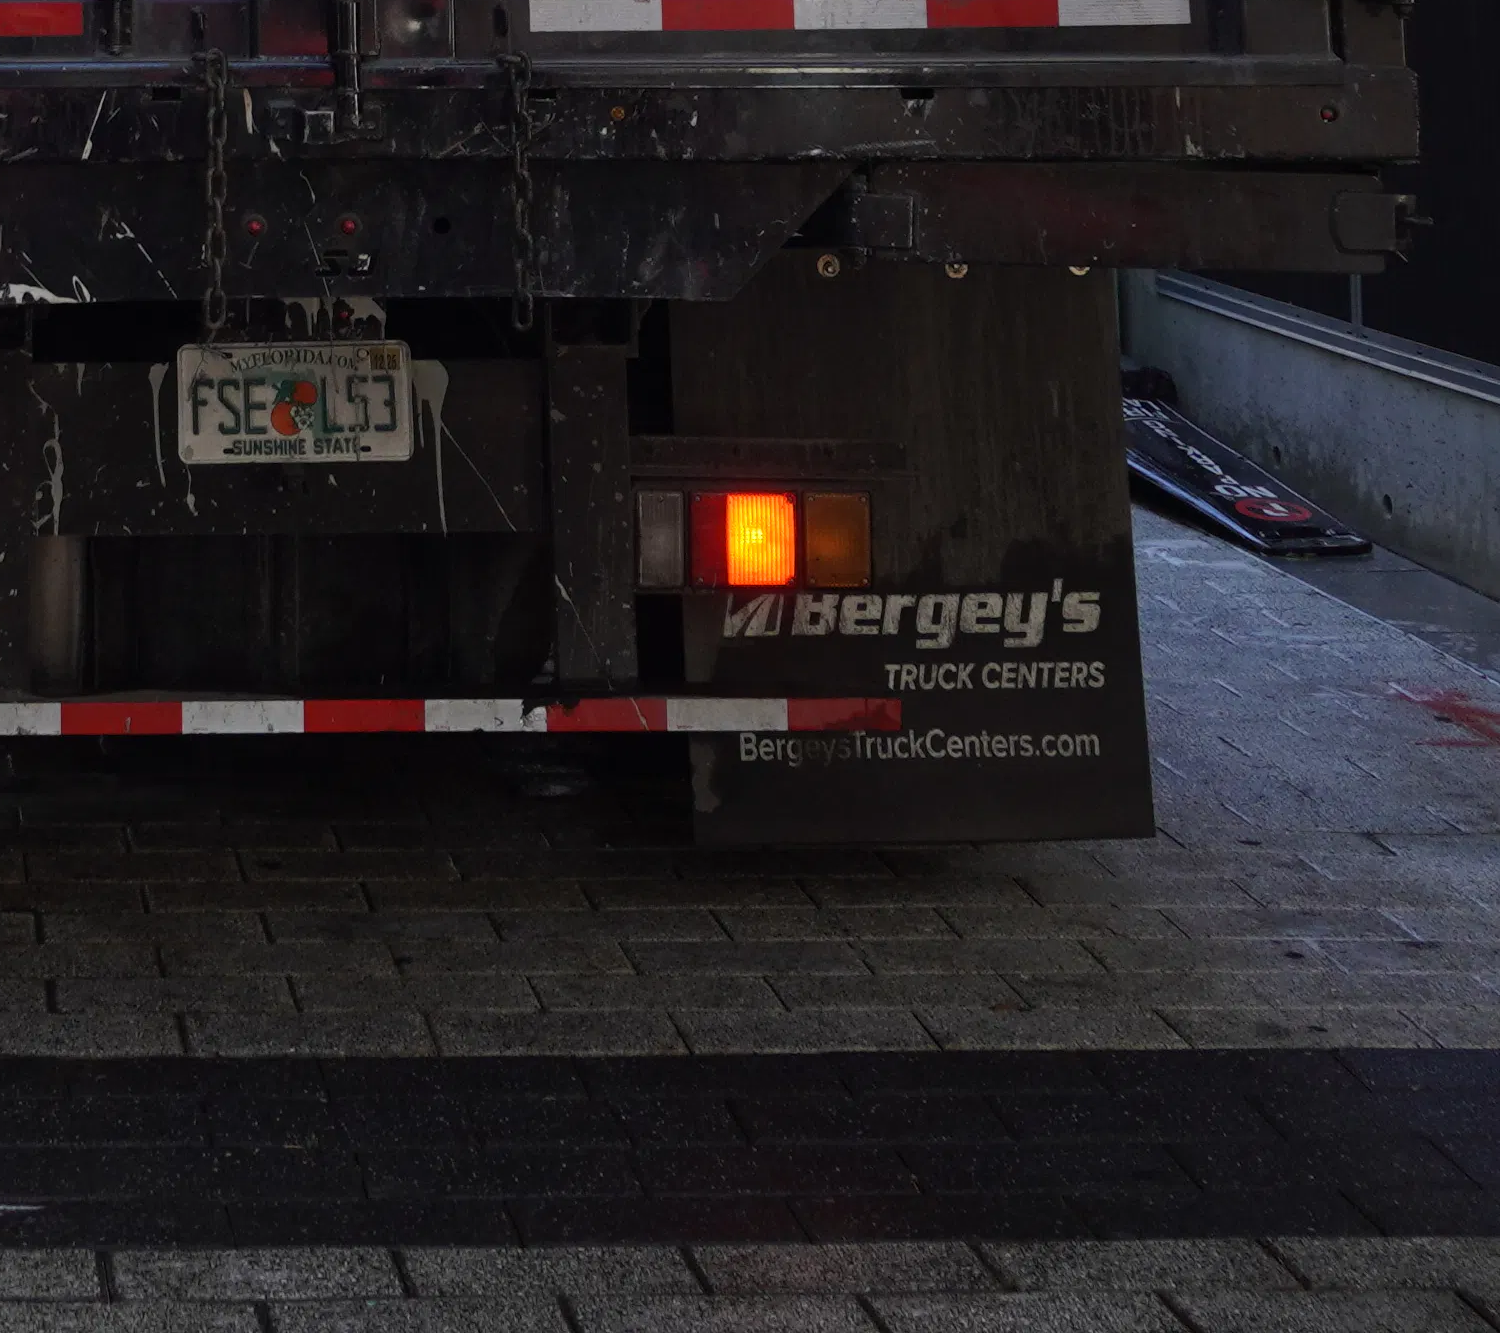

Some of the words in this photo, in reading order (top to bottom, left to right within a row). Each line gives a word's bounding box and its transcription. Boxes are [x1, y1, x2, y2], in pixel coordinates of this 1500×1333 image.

[190, 378, 267, 435] FSE
[323, 376, 398, 433] L53
[233, 439, 306, 455] SUNSHINE
[313, 437, 359, 454] STATE
[1142, 420, 1239, 485] PARKING
[1215, 485, 1278, 499] NO
[792, 578, 1101, 650] Bergey's
[885, 663, 975, 691] TRUCK
[982, 661, 1106, 690] CENTERS
[739, 729, 1101, 767] BergeysTruckCenters.com
